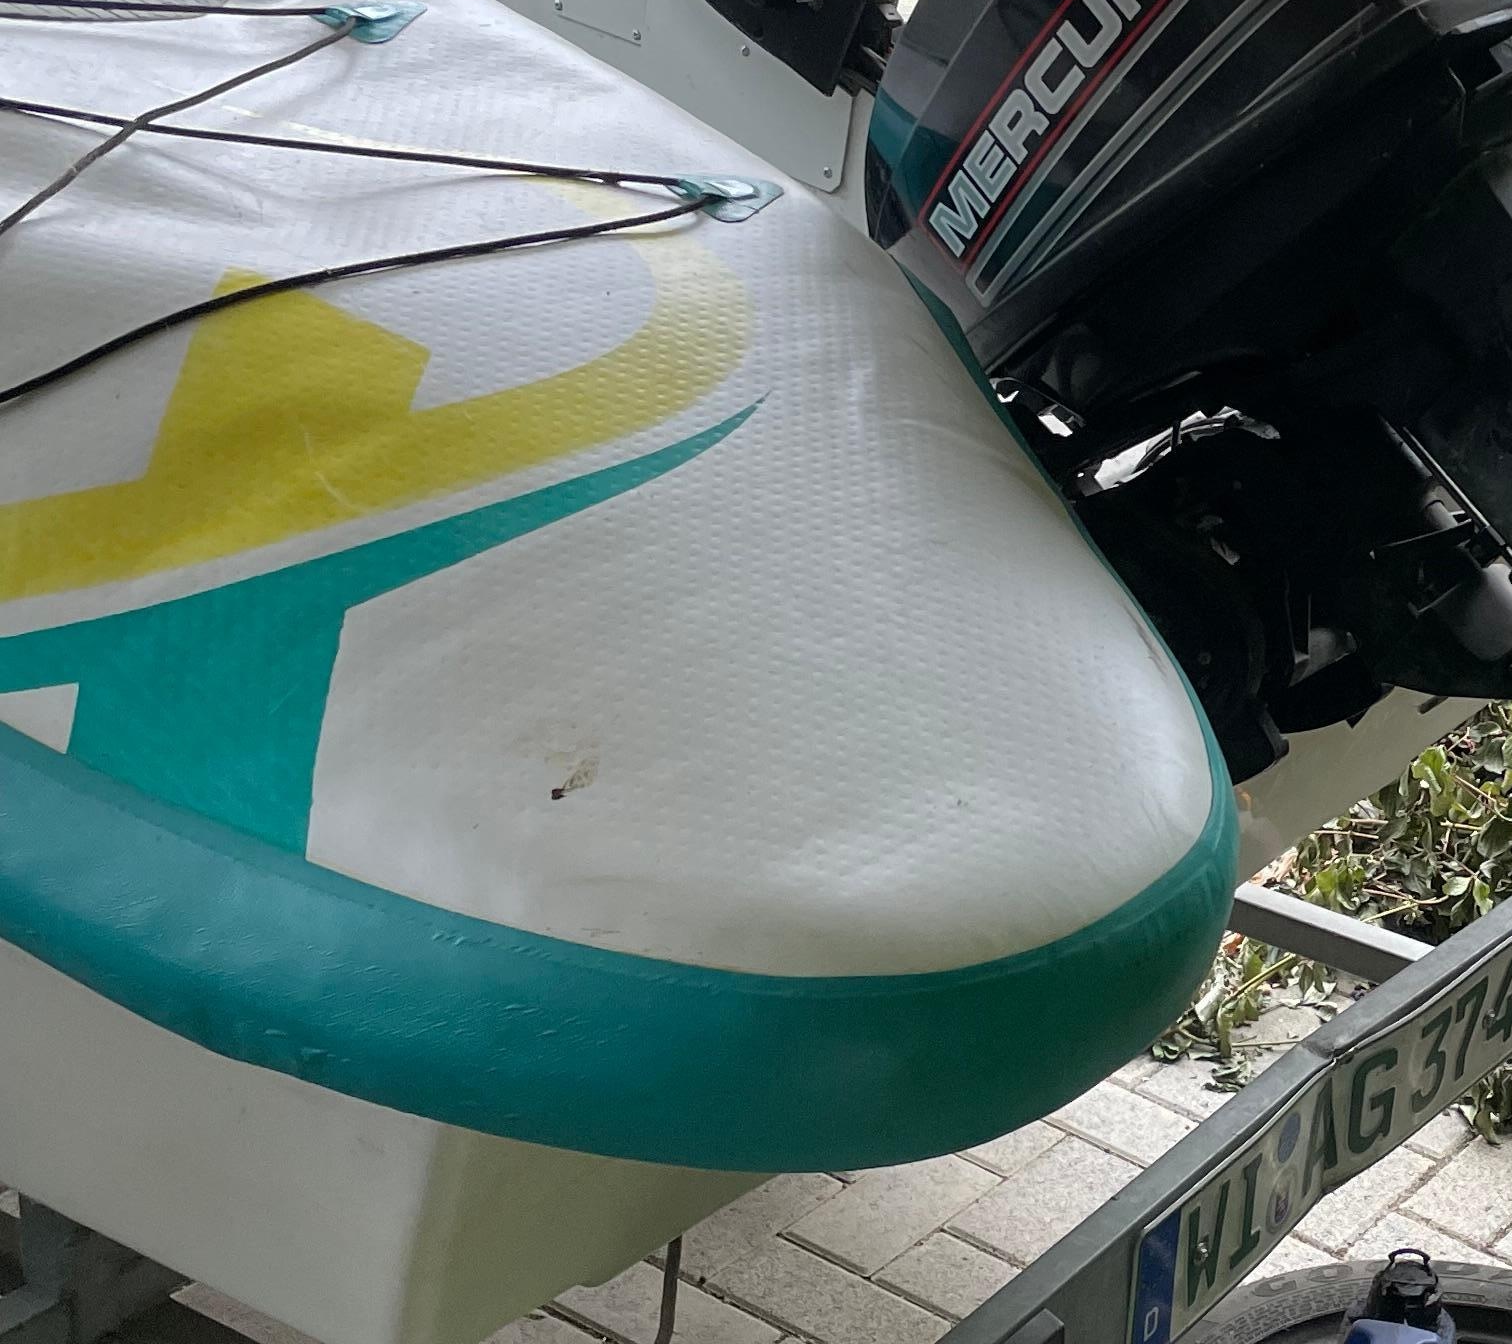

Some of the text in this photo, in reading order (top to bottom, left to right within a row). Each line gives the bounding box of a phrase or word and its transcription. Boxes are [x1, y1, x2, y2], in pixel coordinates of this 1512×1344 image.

[1187, 1157, 1263, 1309] WI
[1301, 1046, 1400, 1197] AG
[1143, 1305, 1160, 1343] D
